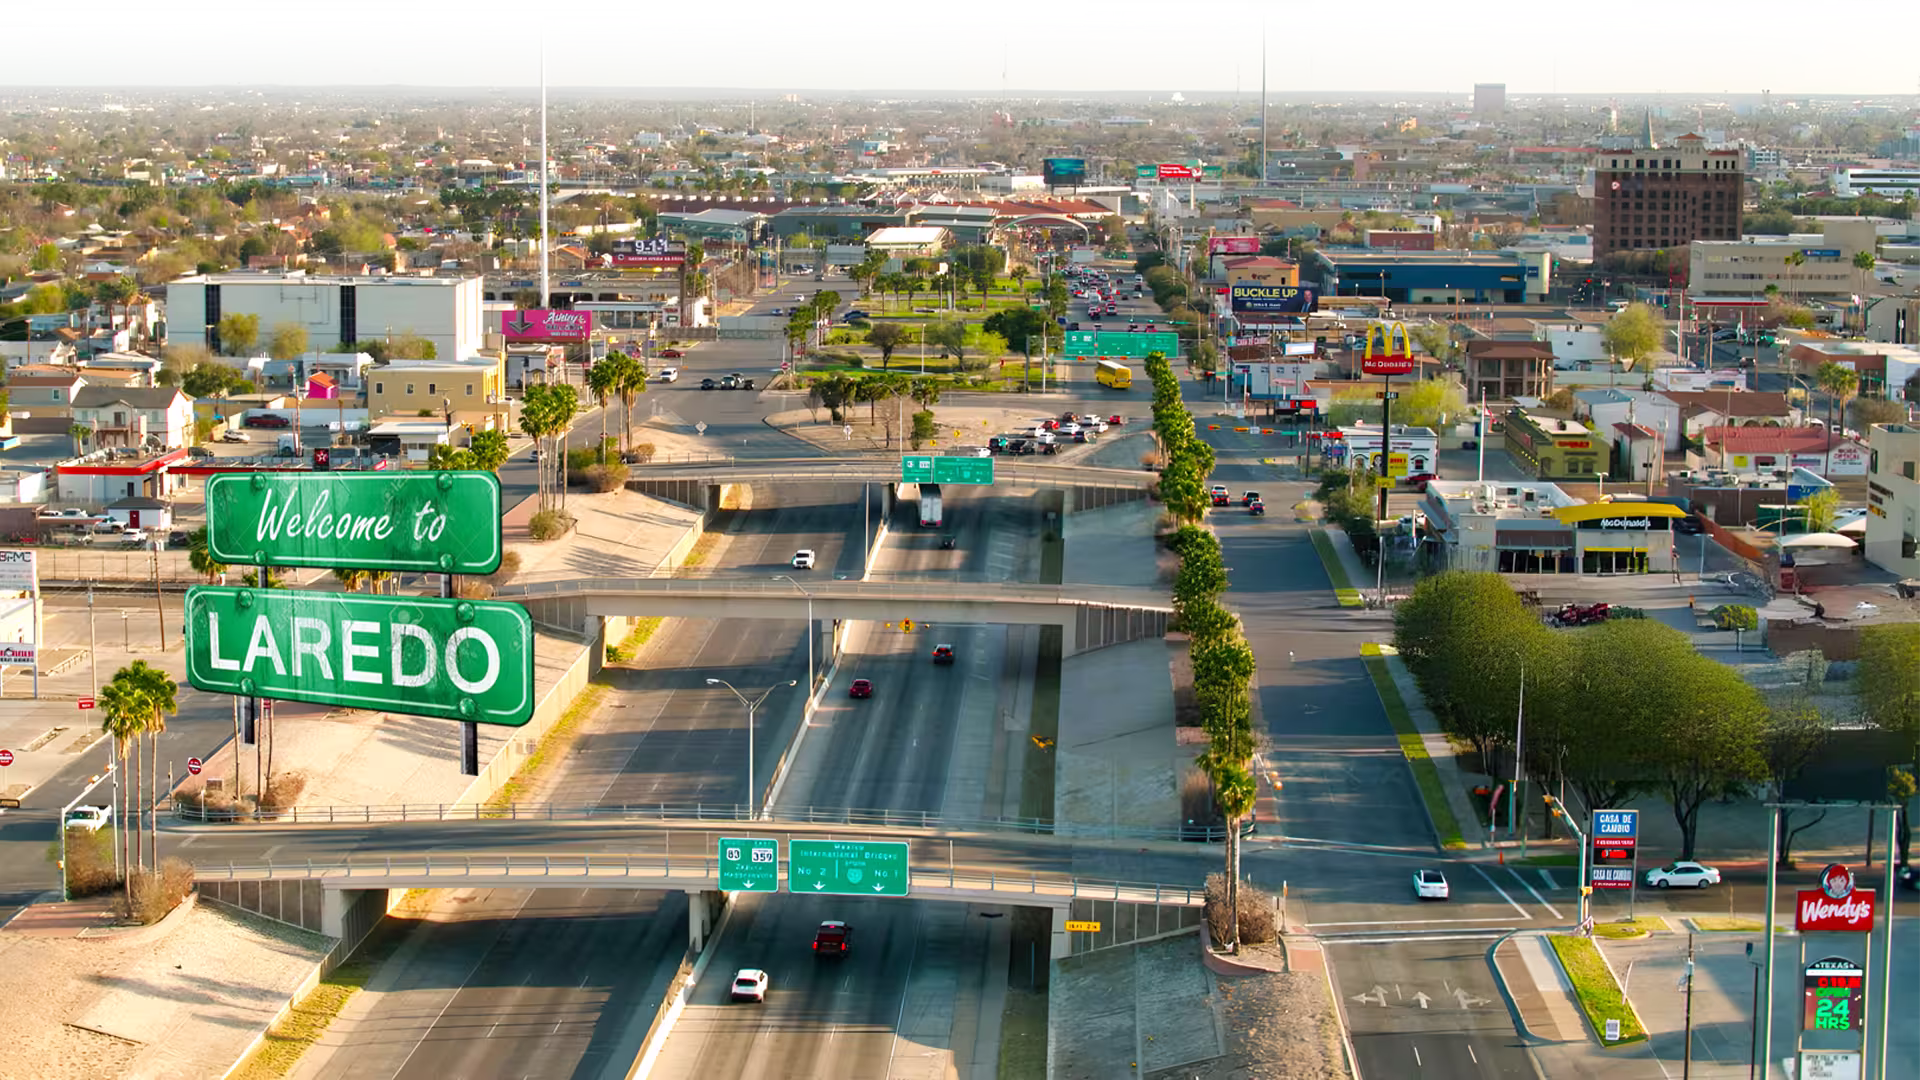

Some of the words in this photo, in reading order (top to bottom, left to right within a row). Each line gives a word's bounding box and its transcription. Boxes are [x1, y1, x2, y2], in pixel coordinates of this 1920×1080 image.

[1234, 287, 1280, 297] BUCKLE
[1282, 288, 1298, 298] UP
[1600, 814, 1619, 823] CASA
[1622, 814, 1632, 823] DE
[1601, 824, 1630, 833] CAMBIO
[819, 867, 827, 876] 2
[1802, 896, 1870, 924] Wendy's
[1820, 961, 1849, 969] TEXAS
[1816, 999, 1850, 1019] 24
[1815, 1017, 1850, 1031] HRS
